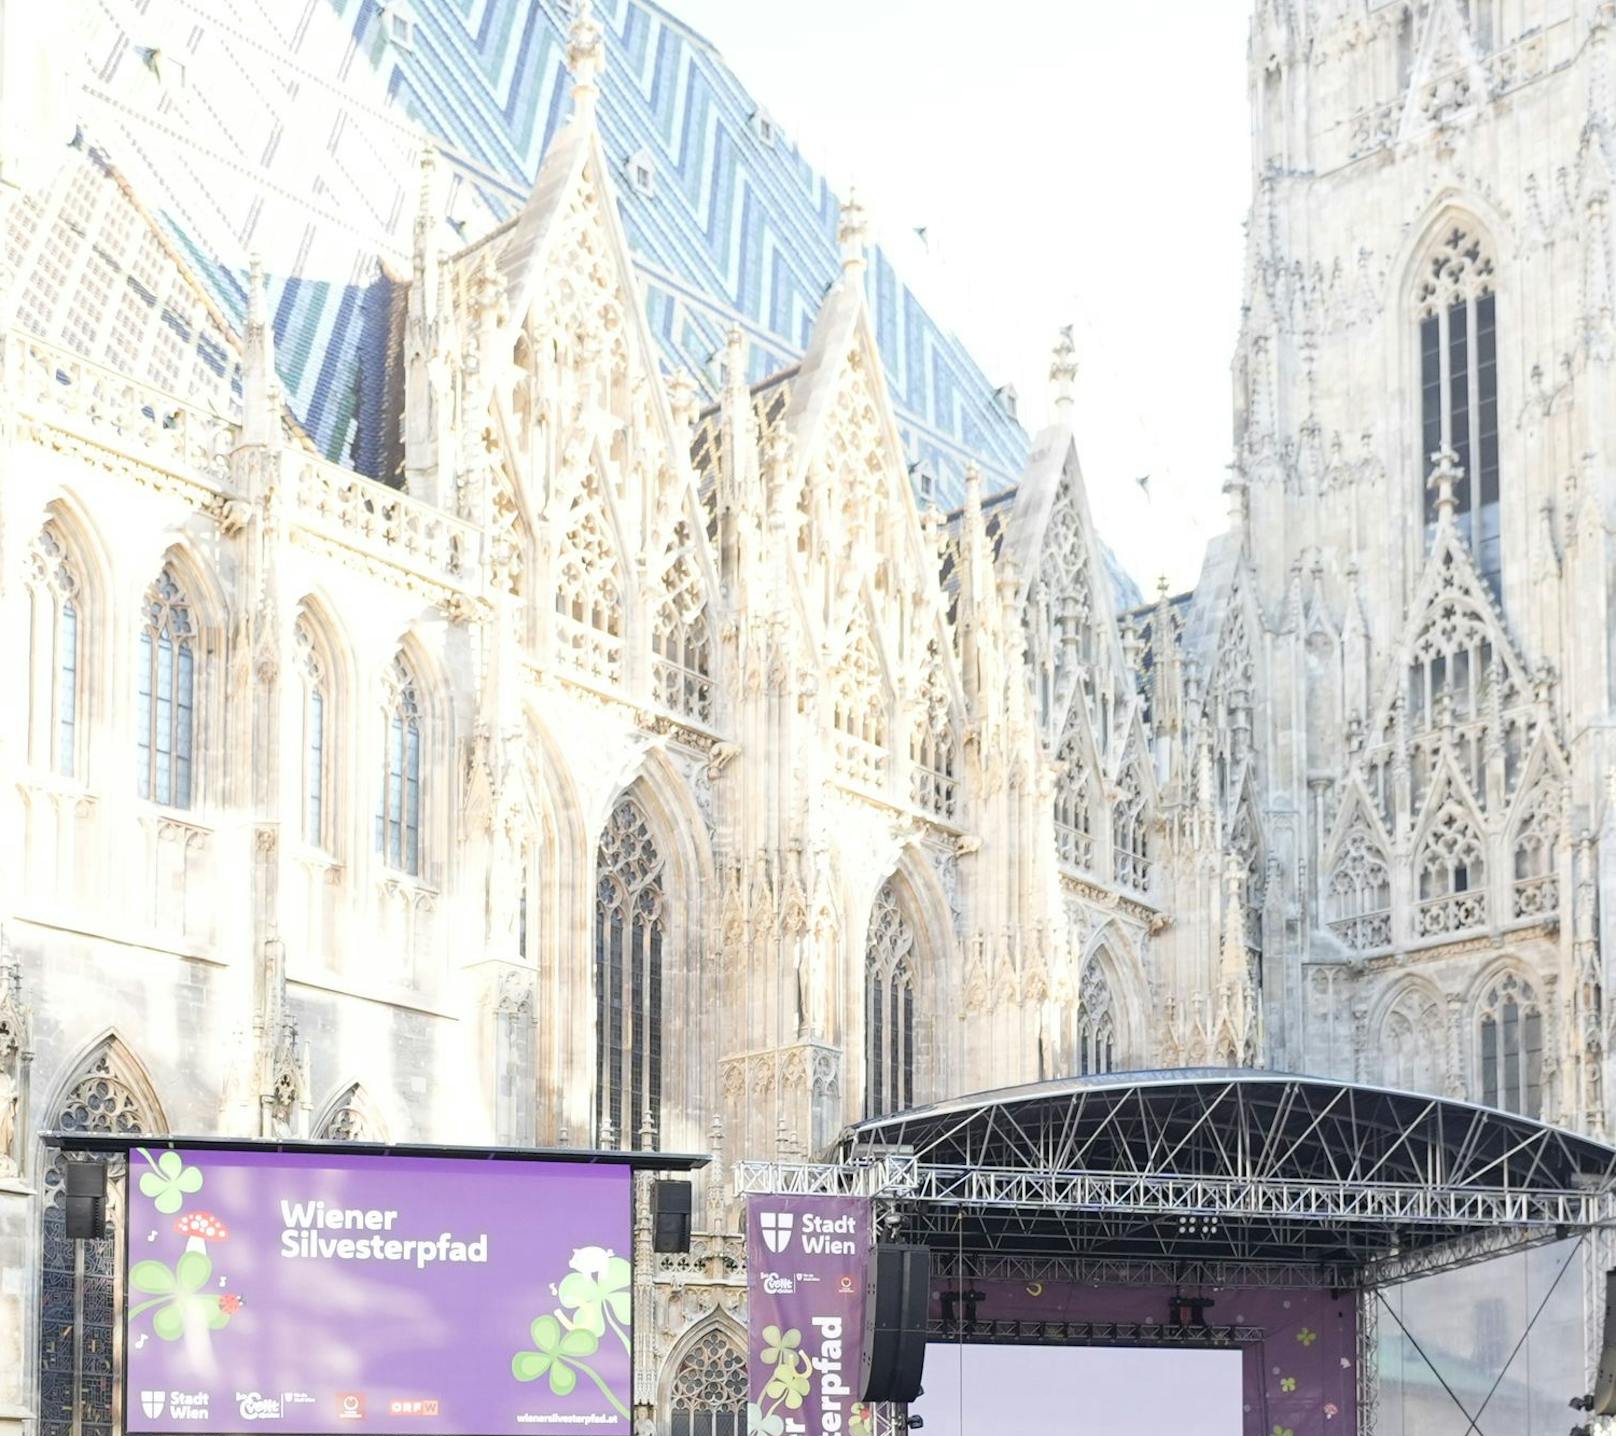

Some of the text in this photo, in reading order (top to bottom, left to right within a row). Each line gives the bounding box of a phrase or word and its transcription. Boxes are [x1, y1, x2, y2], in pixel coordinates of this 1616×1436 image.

[279, 1200, 398, 1230] Wiener
[802, 1213, 856, 1234] Stadt
[280, 1229, 488, 1269] Silvesterpfad
[801, 1235, 856, 1255] Wien
[170, 1391, 209, 1405] Stadt
[170, 1405, 209, 1420] Wien
